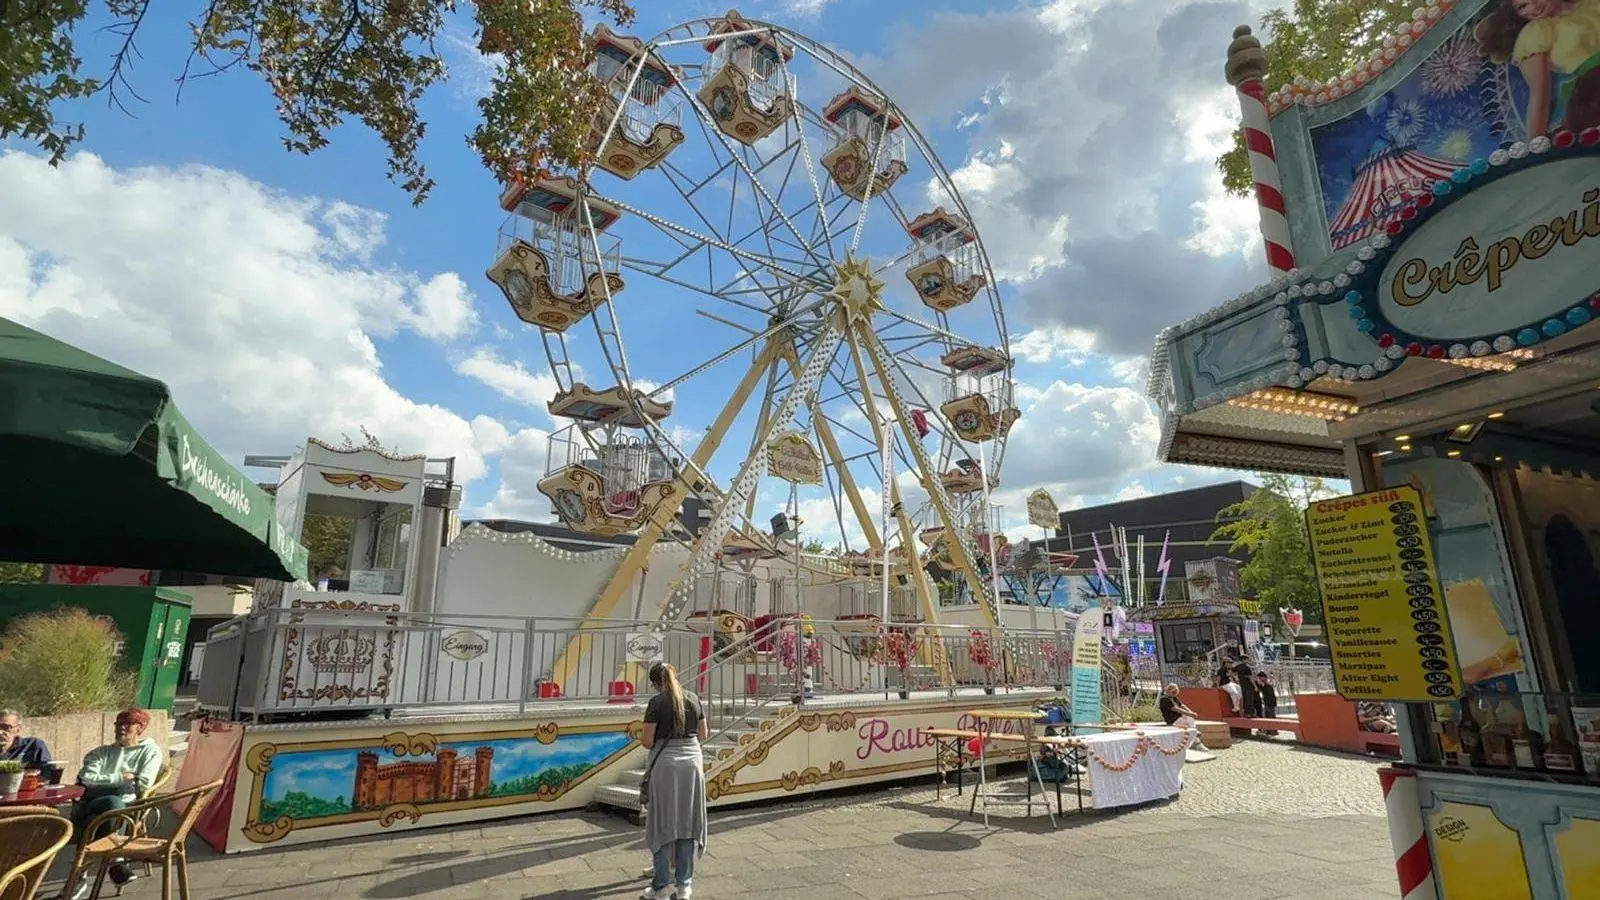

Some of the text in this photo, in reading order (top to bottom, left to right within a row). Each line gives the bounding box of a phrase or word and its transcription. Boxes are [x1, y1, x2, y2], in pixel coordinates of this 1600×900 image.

[1370, 176, 1436, 217] CIRCUS
[1317, 491, 1400, 513] Crêpes süß
[1313, 515, 1346, 525] Zucker
[1315, 526, 1348, 536] Zucker
[1360, 519, 1384, 529] Zimt
[1317, 532, 1378, 546] Puderzucker
[1318, 547, 1353, 557] Nutella
[1320, 553, 1391, 568] Zuckerstreusel
[1327, 589, 1389, 601] Kinderriegel
[1328, 605, 1359, 613] Bueno
[1330, 616, 1360, 625] Duplo
[1333, 627, 1382, 636] Yogurette
[445, 637, 483, 654] Eingang
[1335, 638, 1398, 647] Vanillesauce
[1337, 651, 1381, 659] Smarties
[1339, 662, 1386, 671] Marzipan
[1342, 674, 1368, 682] After
[1371, 673, 1399, 684] Eight
[1435, 819, 1466, 837] DESIGN
